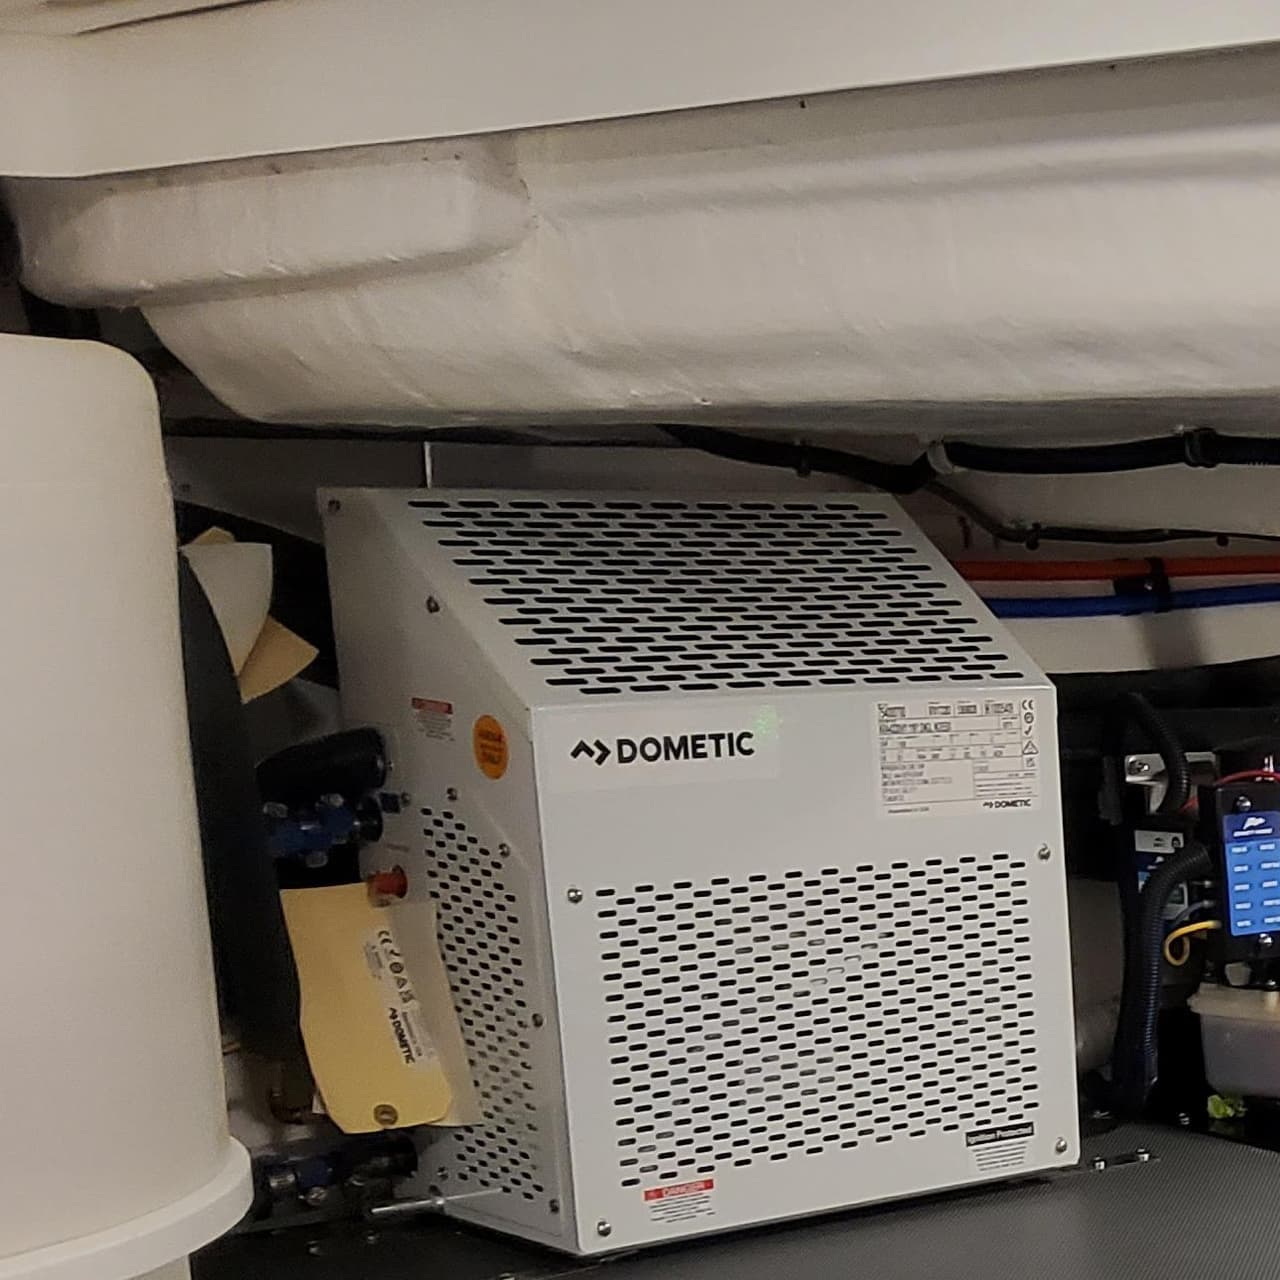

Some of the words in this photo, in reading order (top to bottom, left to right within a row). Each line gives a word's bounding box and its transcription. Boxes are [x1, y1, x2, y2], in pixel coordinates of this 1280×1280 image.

[616, 731, 755, 764] DOMETIC
[994, 799, 1032, 808] DOMETIC
[662, 1180, 705, 1198] DANGER
